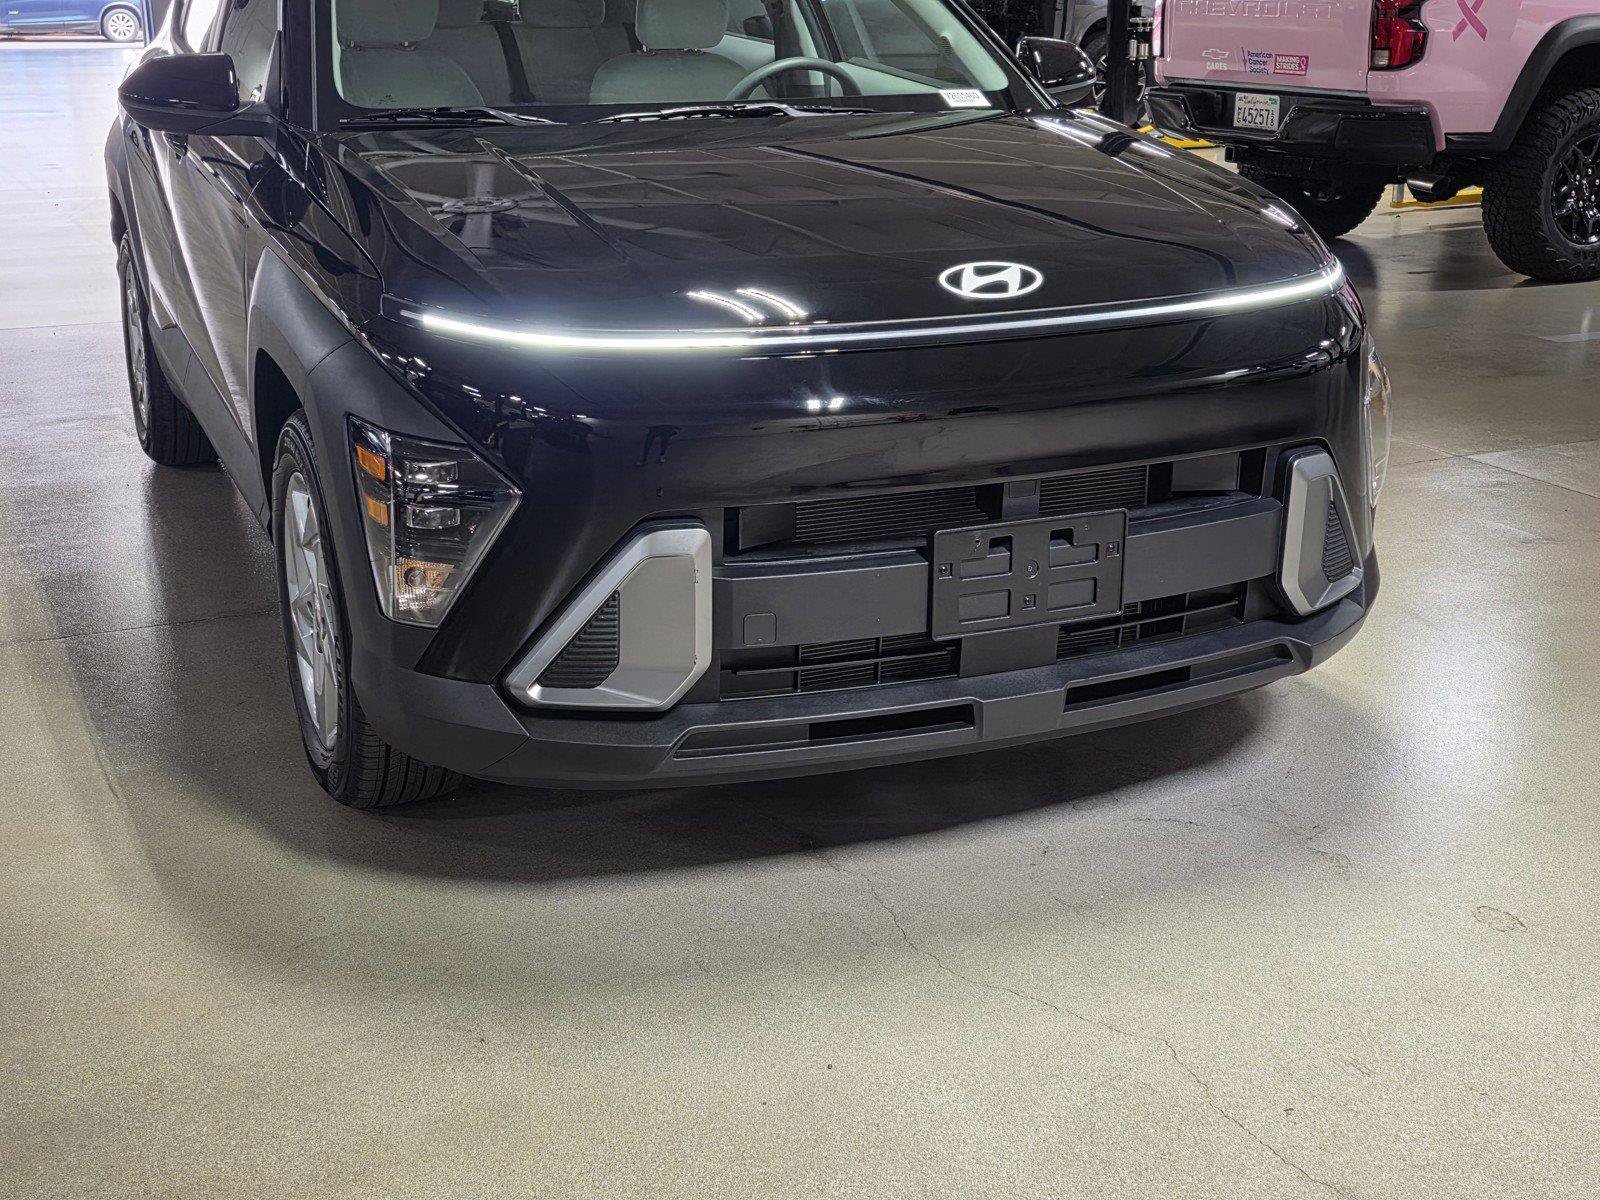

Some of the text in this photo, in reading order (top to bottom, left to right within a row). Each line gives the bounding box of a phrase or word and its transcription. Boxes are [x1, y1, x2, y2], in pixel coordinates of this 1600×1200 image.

[1247, 50, 1273, 59] American
[1276, 56, 1300, 64] MAKING
[1249, 66, 1270, 75] Society
[1275, 62, 1299, 71] STRIDES
